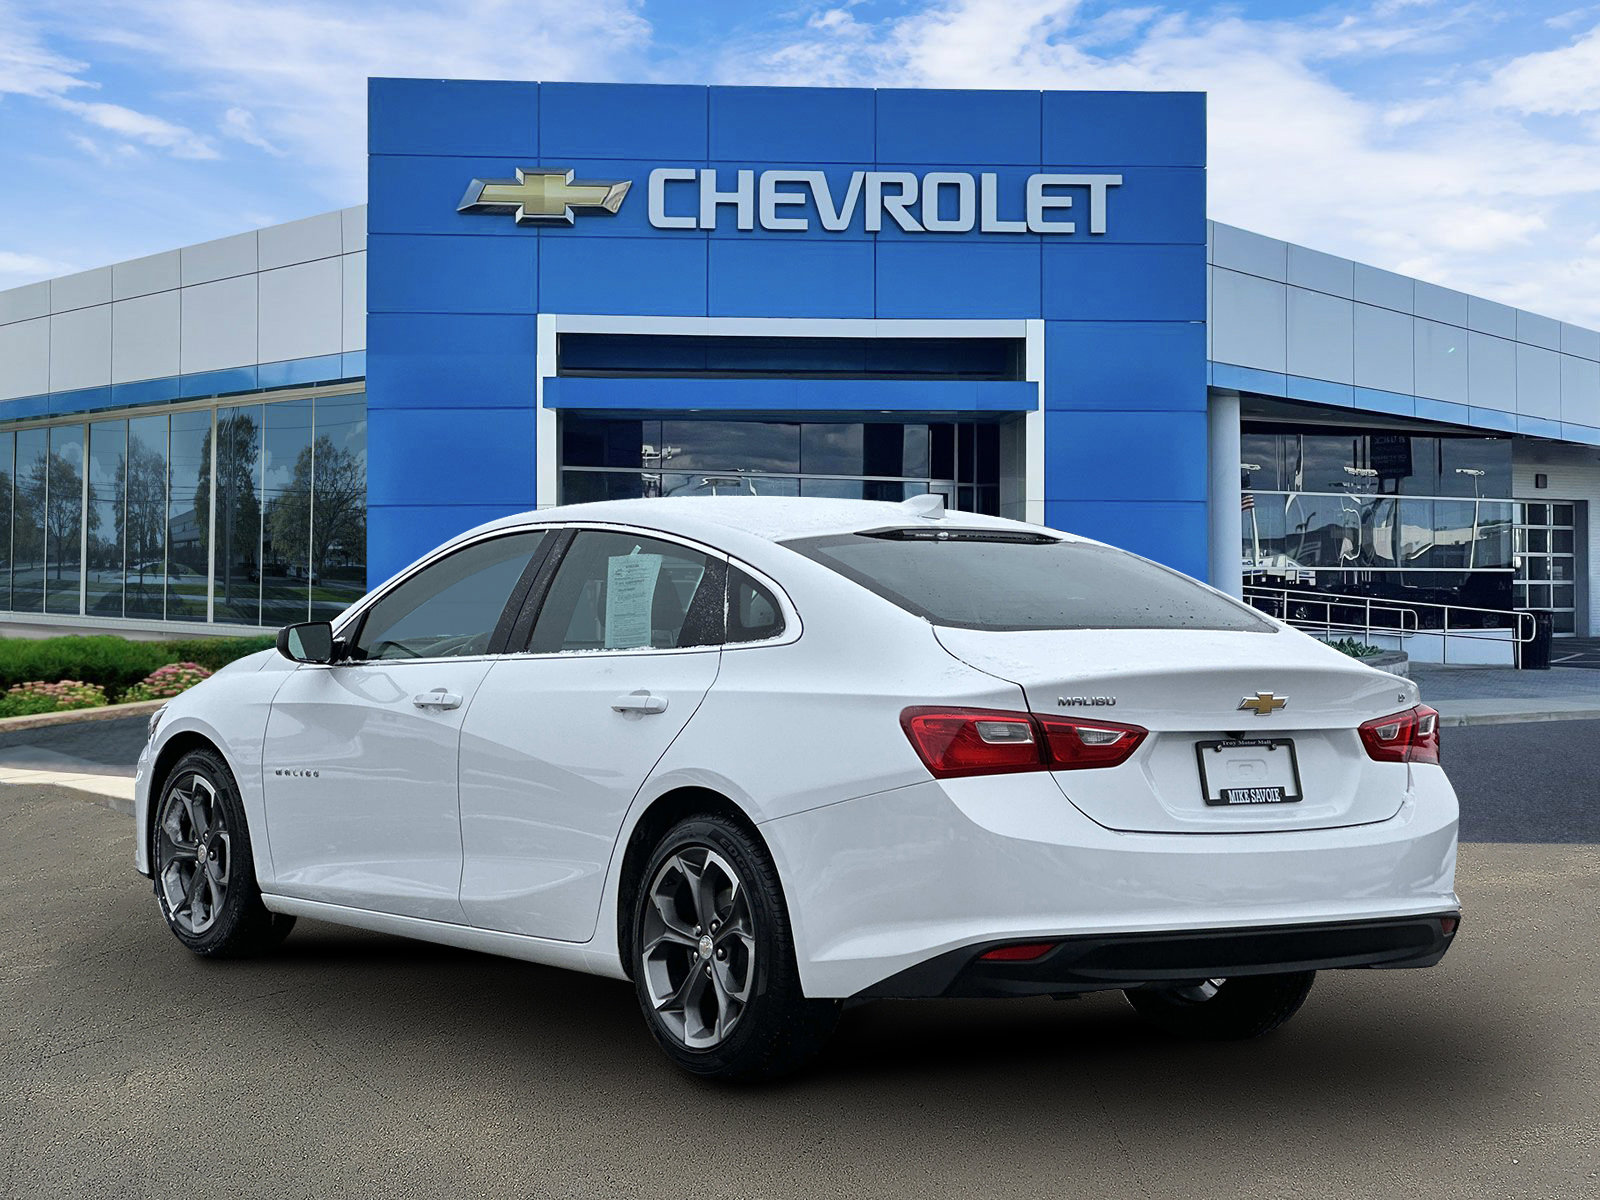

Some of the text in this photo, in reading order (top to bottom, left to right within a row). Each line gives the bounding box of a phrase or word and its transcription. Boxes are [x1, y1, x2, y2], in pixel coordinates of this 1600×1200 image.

[648, 168, 1123, 234] CHEVROLET
[1058, 696, 1117, 706] MALIBU
[1228, 788, 1280, 803] MIKE SAVOIE
